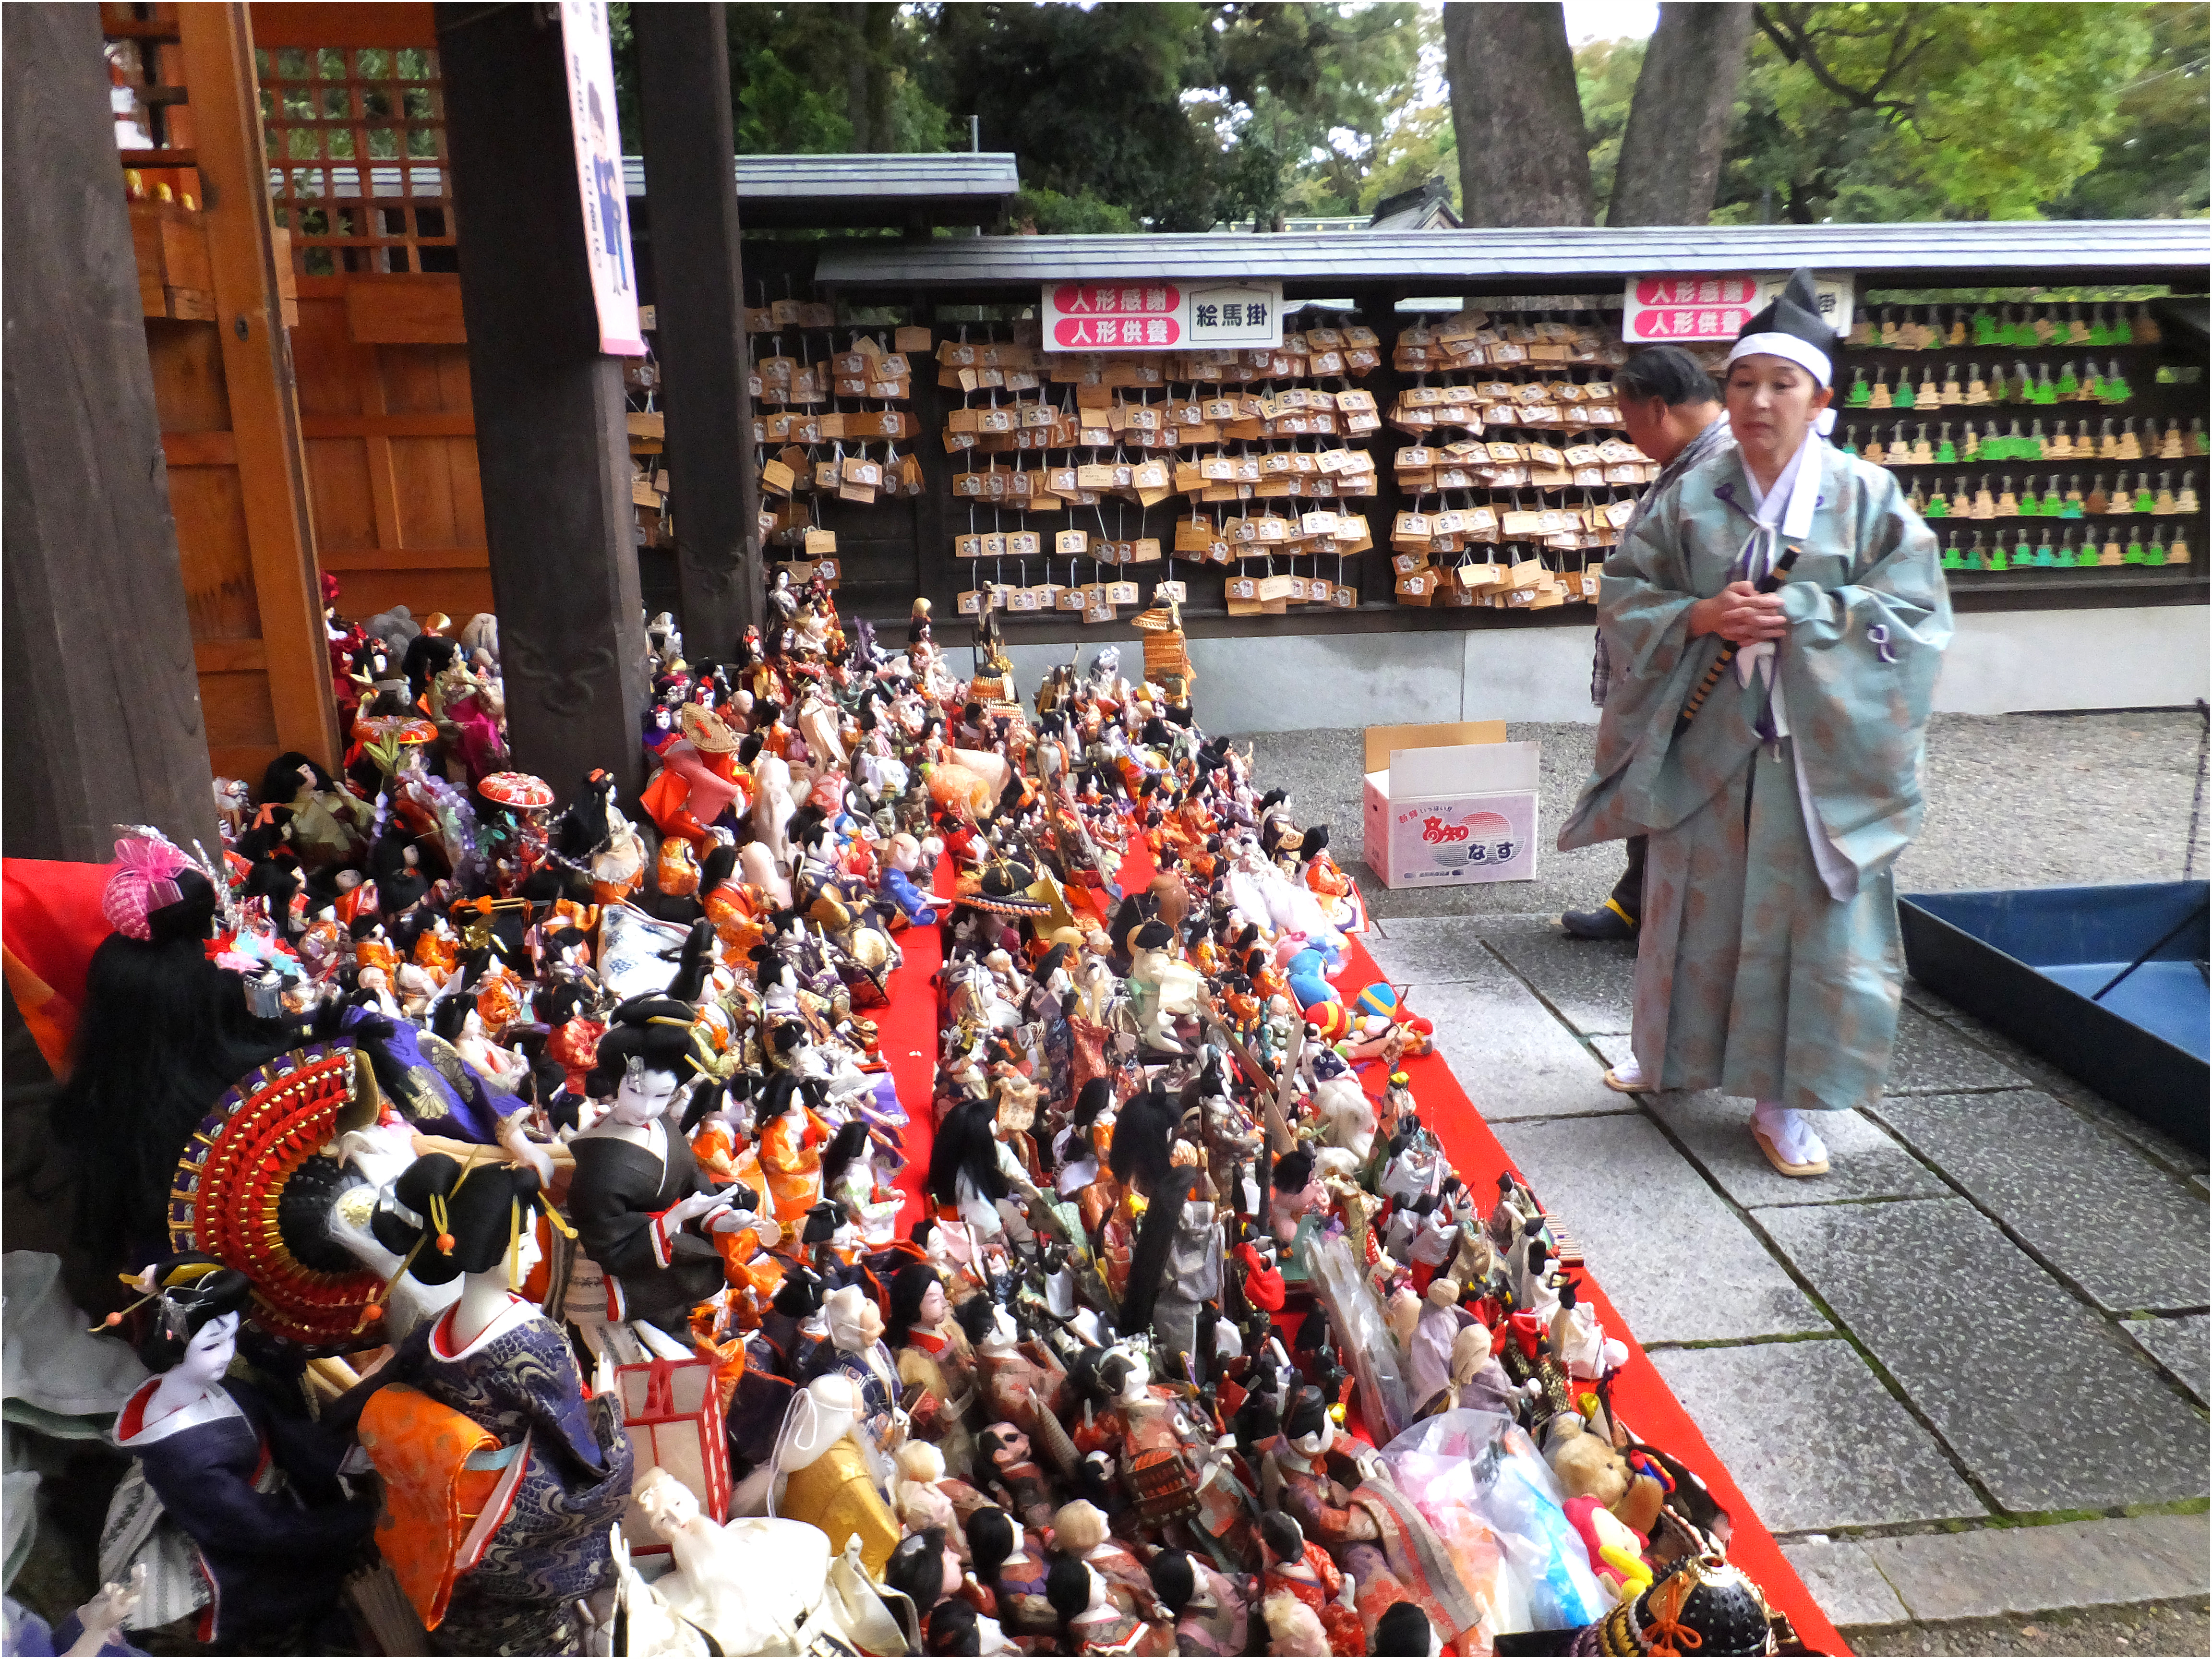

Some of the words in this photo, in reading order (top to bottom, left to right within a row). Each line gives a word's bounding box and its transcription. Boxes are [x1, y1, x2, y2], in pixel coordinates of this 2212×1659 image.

[1070, 289, 1167, 313] 人形感謝
[1197, 303, 1267, 327] 絵馬掛
[1070, 320, 1167, 344] 人形供養
[1422, 816, 1469, 845] 高知
[1468, 842, 1514, 860] なす
